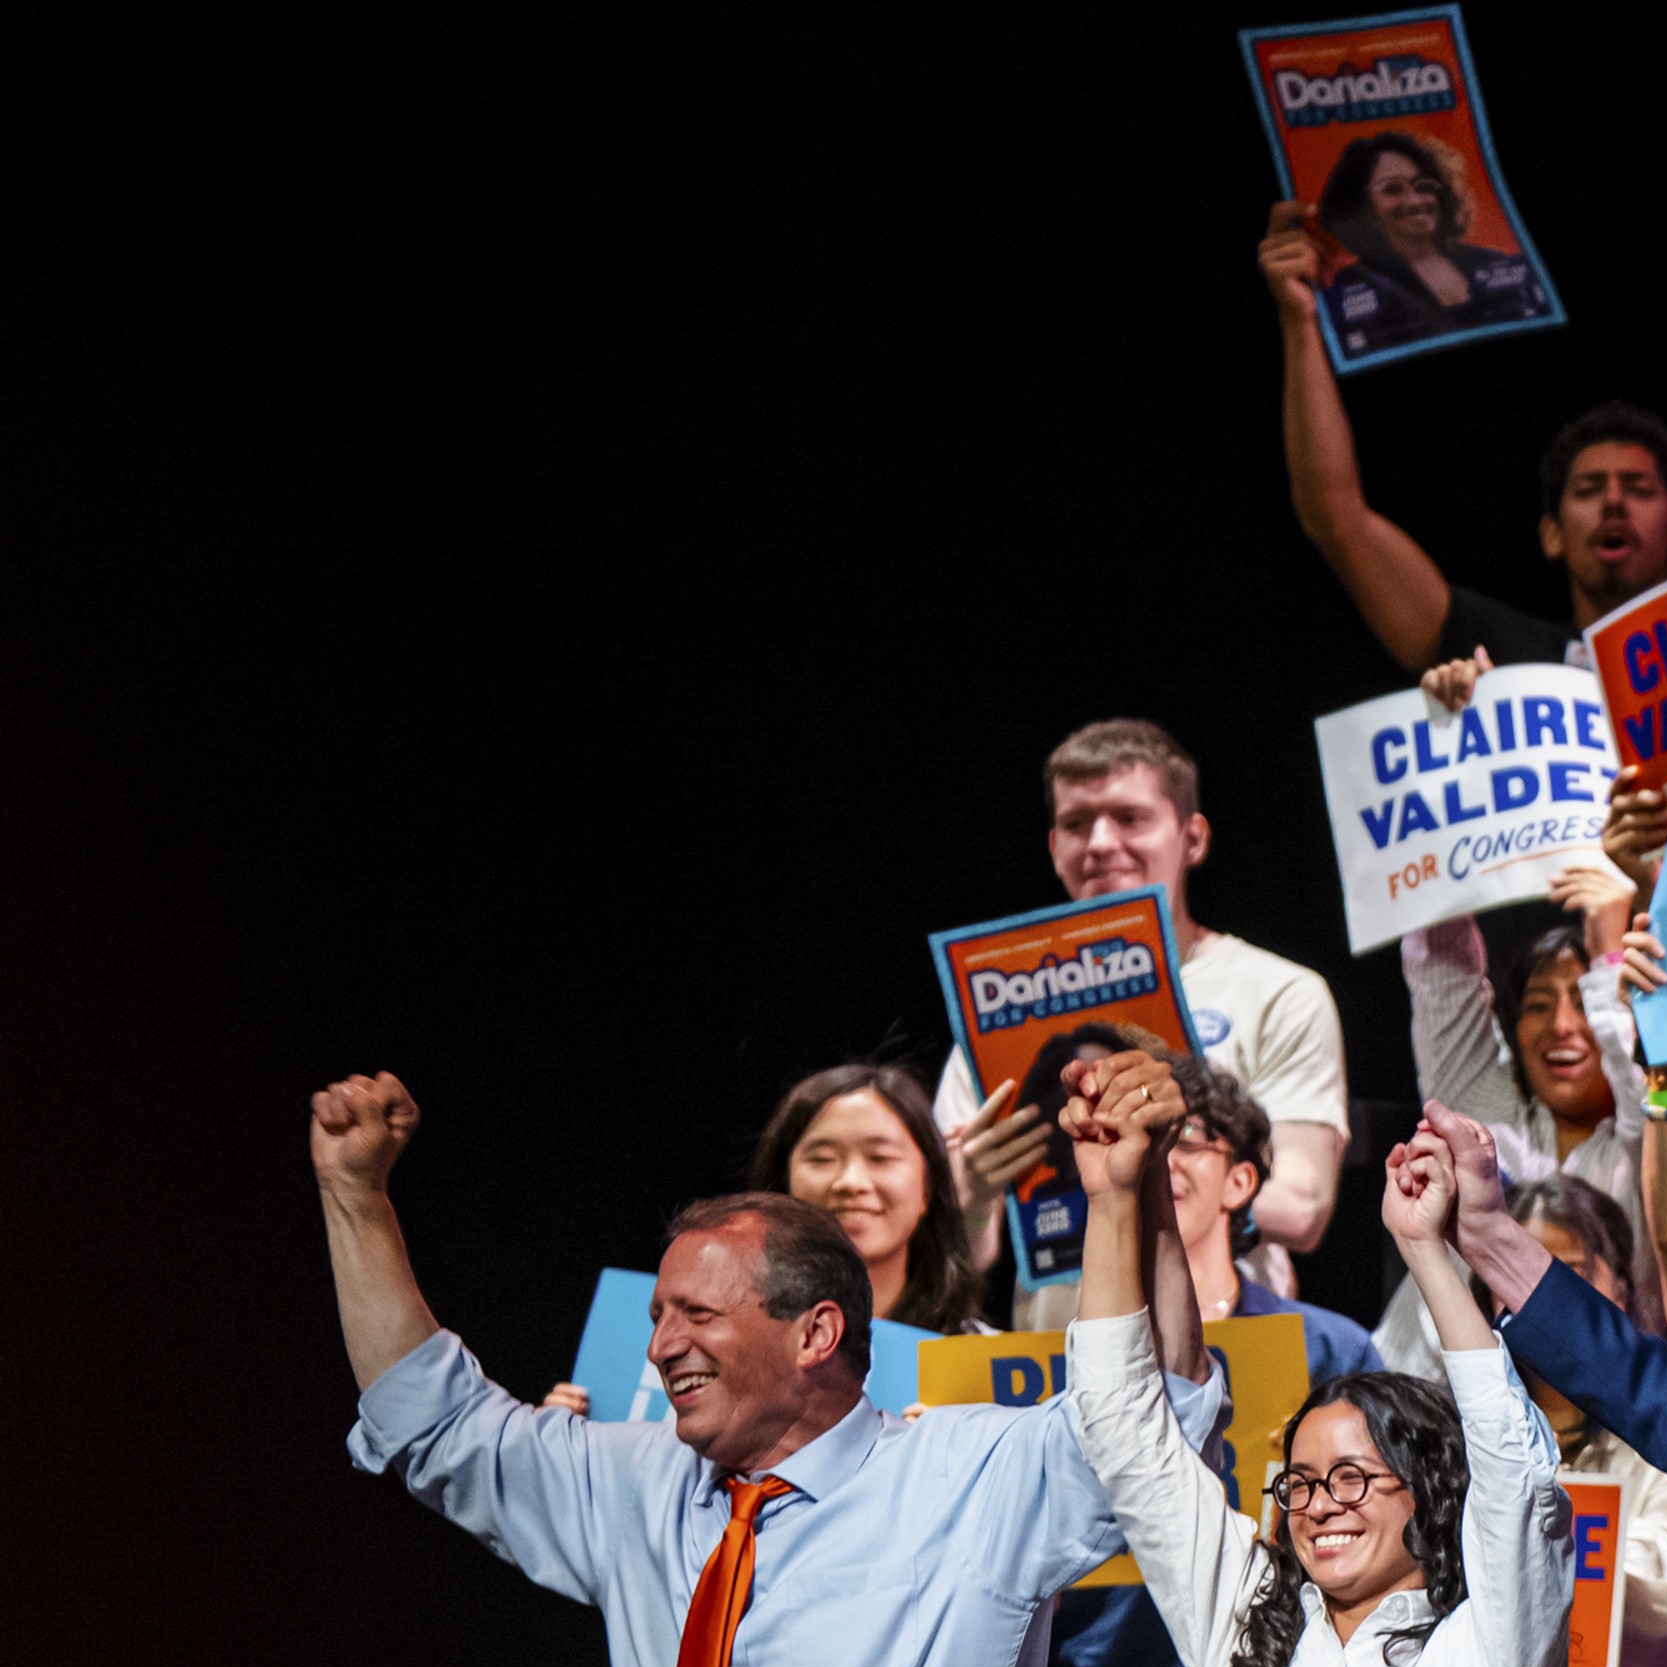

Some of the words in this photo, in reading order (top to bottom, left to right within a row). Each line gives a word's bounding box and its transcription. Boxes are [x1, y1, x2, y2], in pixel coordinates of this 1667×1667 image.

[1276, 60, 1450, 110] Darializa
[1370, 697, 1606, 784] CLAIRE
[1389, 854, 1436, 899] FOR
[1447, 817, 1604, 880] CONGRES
[970, 945, 1153, 1014] Darializa
